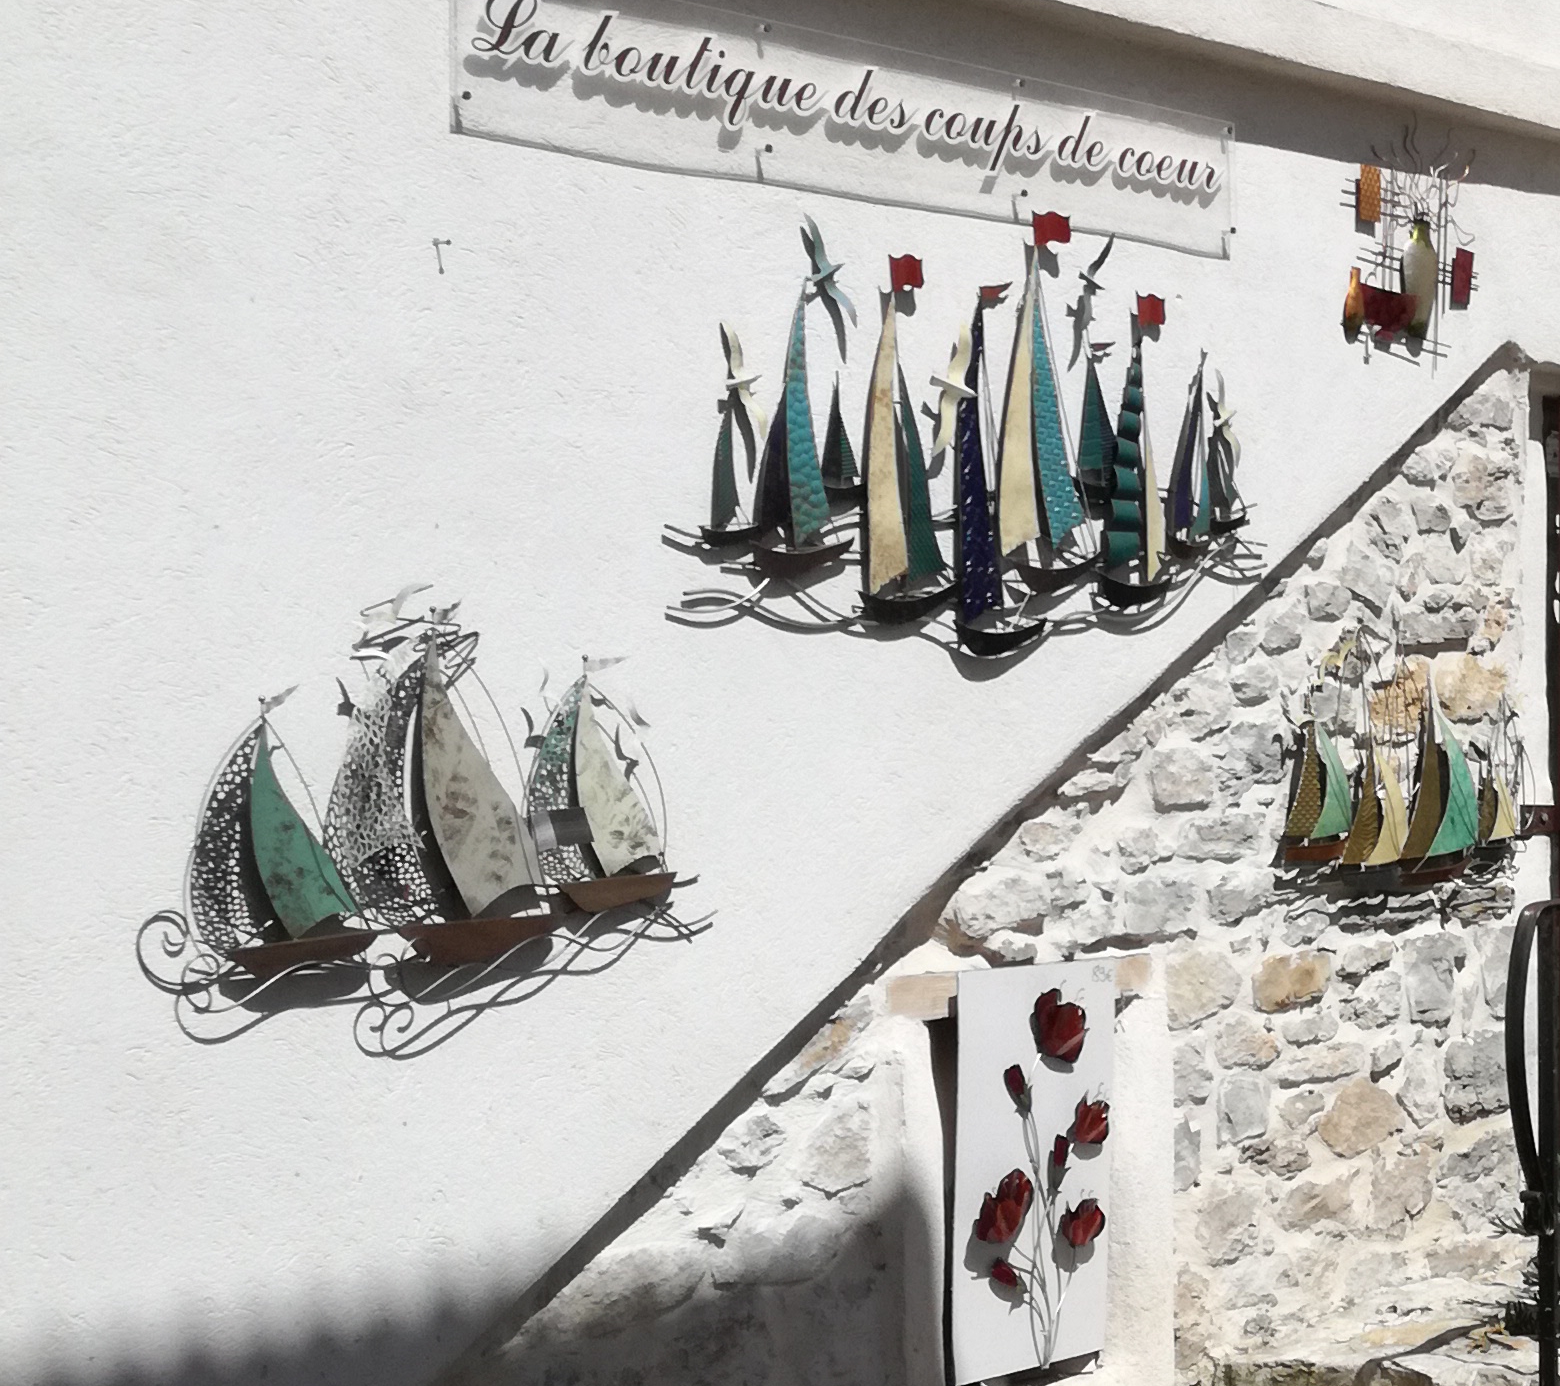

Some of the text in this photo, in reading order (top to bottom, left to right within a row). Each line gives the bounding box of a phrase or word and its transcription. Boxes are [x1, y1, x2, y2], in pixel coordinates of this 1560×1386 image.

[584, 14, 818, 125] boutique
[834, 68, 910, 129] des
[924, 103, 1046, 173] coups
[1058, 115, 1106, 168] de
[1118, 147, 1223, 191] coeur
